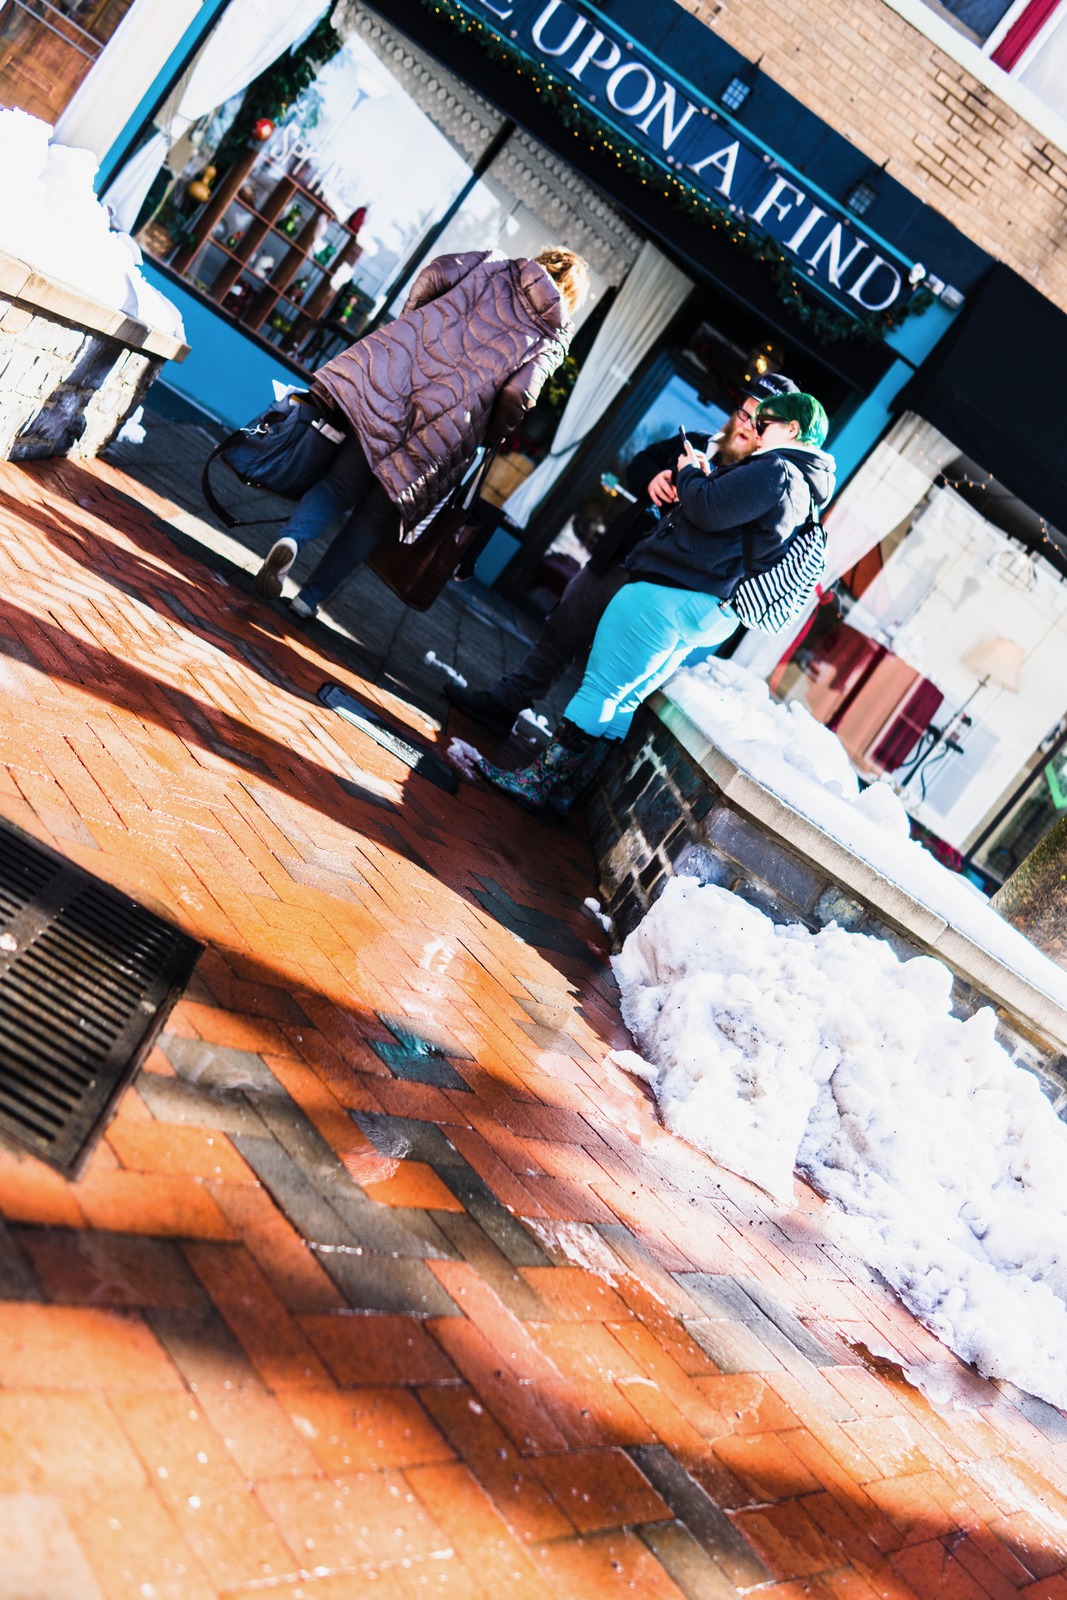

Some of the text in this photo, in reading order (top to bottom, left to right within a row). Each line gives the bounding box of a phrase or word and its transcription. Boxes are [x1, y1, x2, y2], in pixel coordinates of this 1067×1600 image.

[531, 0, 901, 311] UPON A FIND
